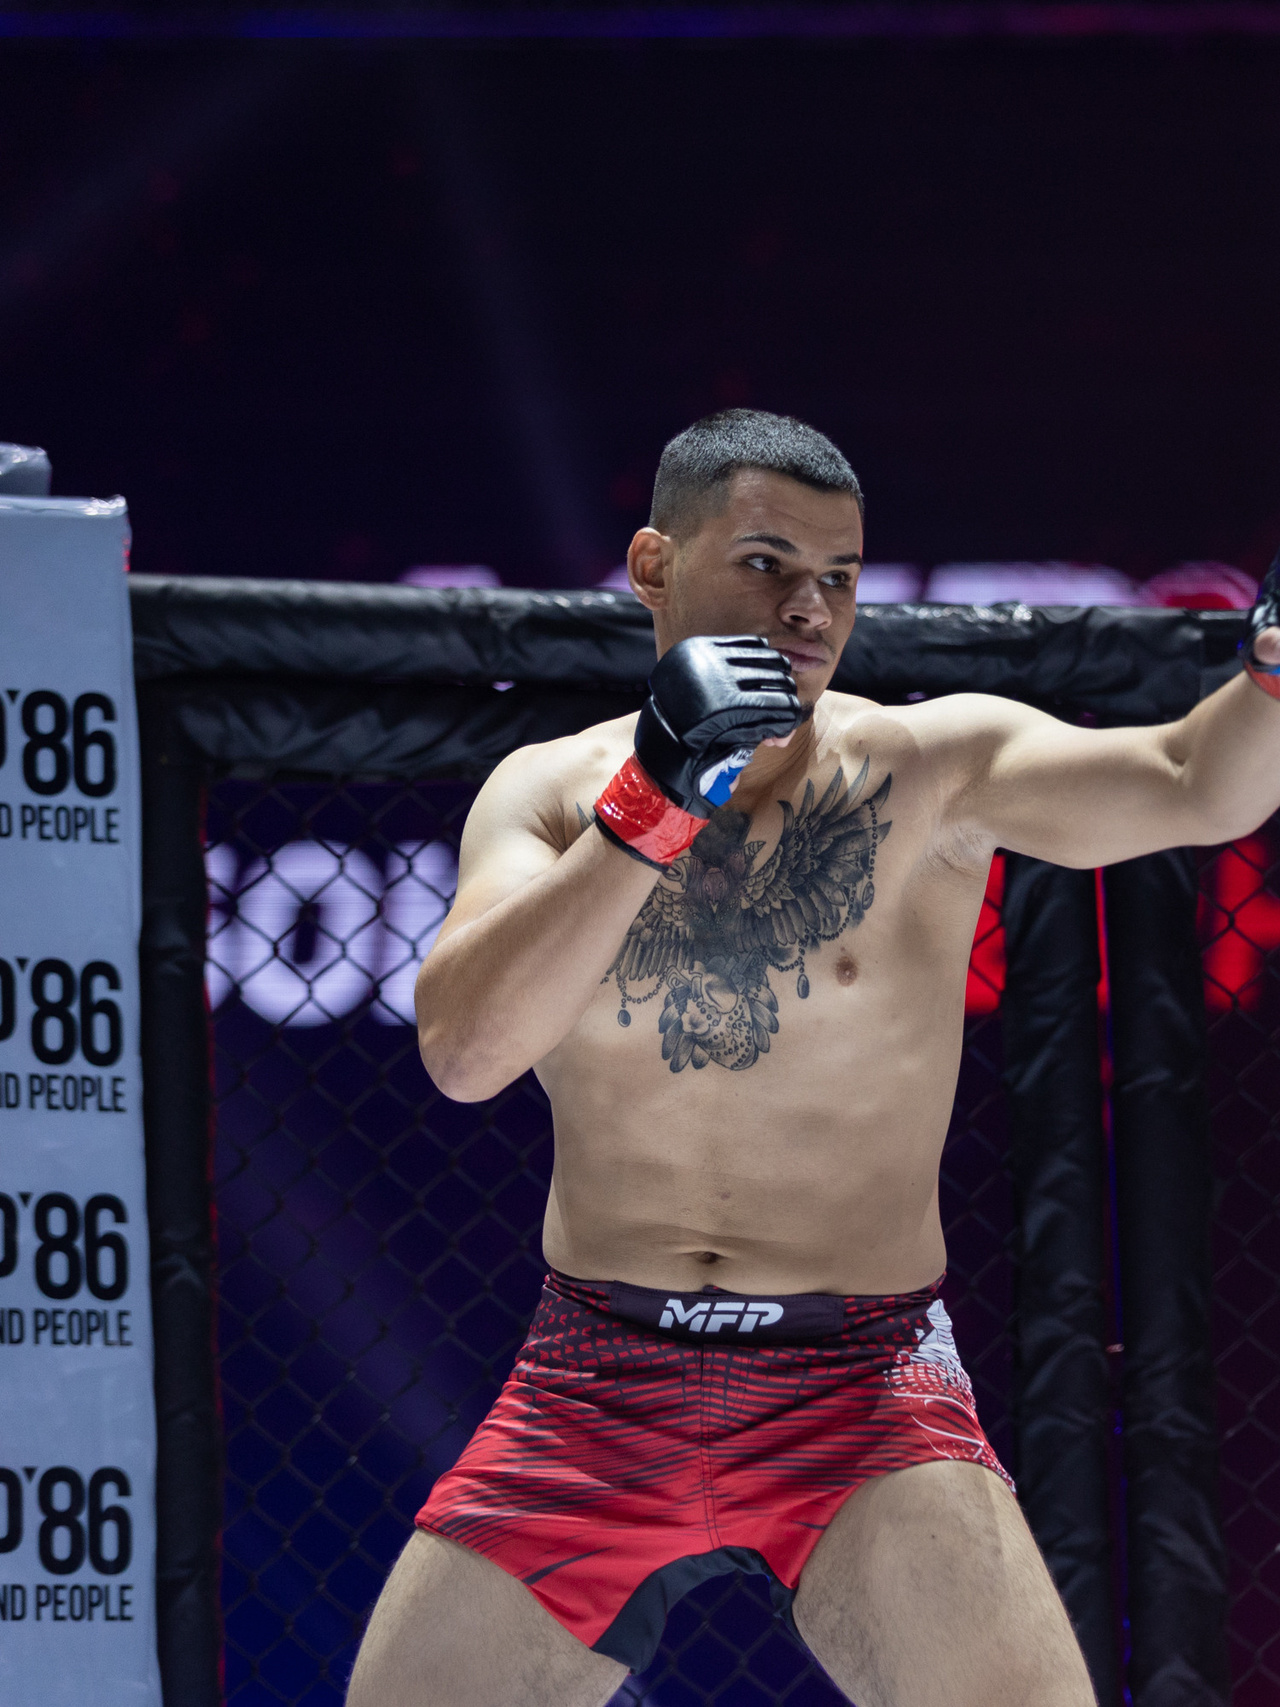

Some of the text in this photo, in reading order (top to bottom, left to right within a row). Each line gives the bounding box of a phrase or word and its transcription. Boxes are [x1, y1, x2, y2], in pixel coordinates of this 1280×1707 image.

[21, 803, 119, 845] PEOPLE
[29, 1073, 126, 1113] PEOPLE
[33, 1308, 133, 1347] PEOPLE
[658, 1299, 784, 1333] MFP
[35, 1583, 134, 1622] PEOPLE
